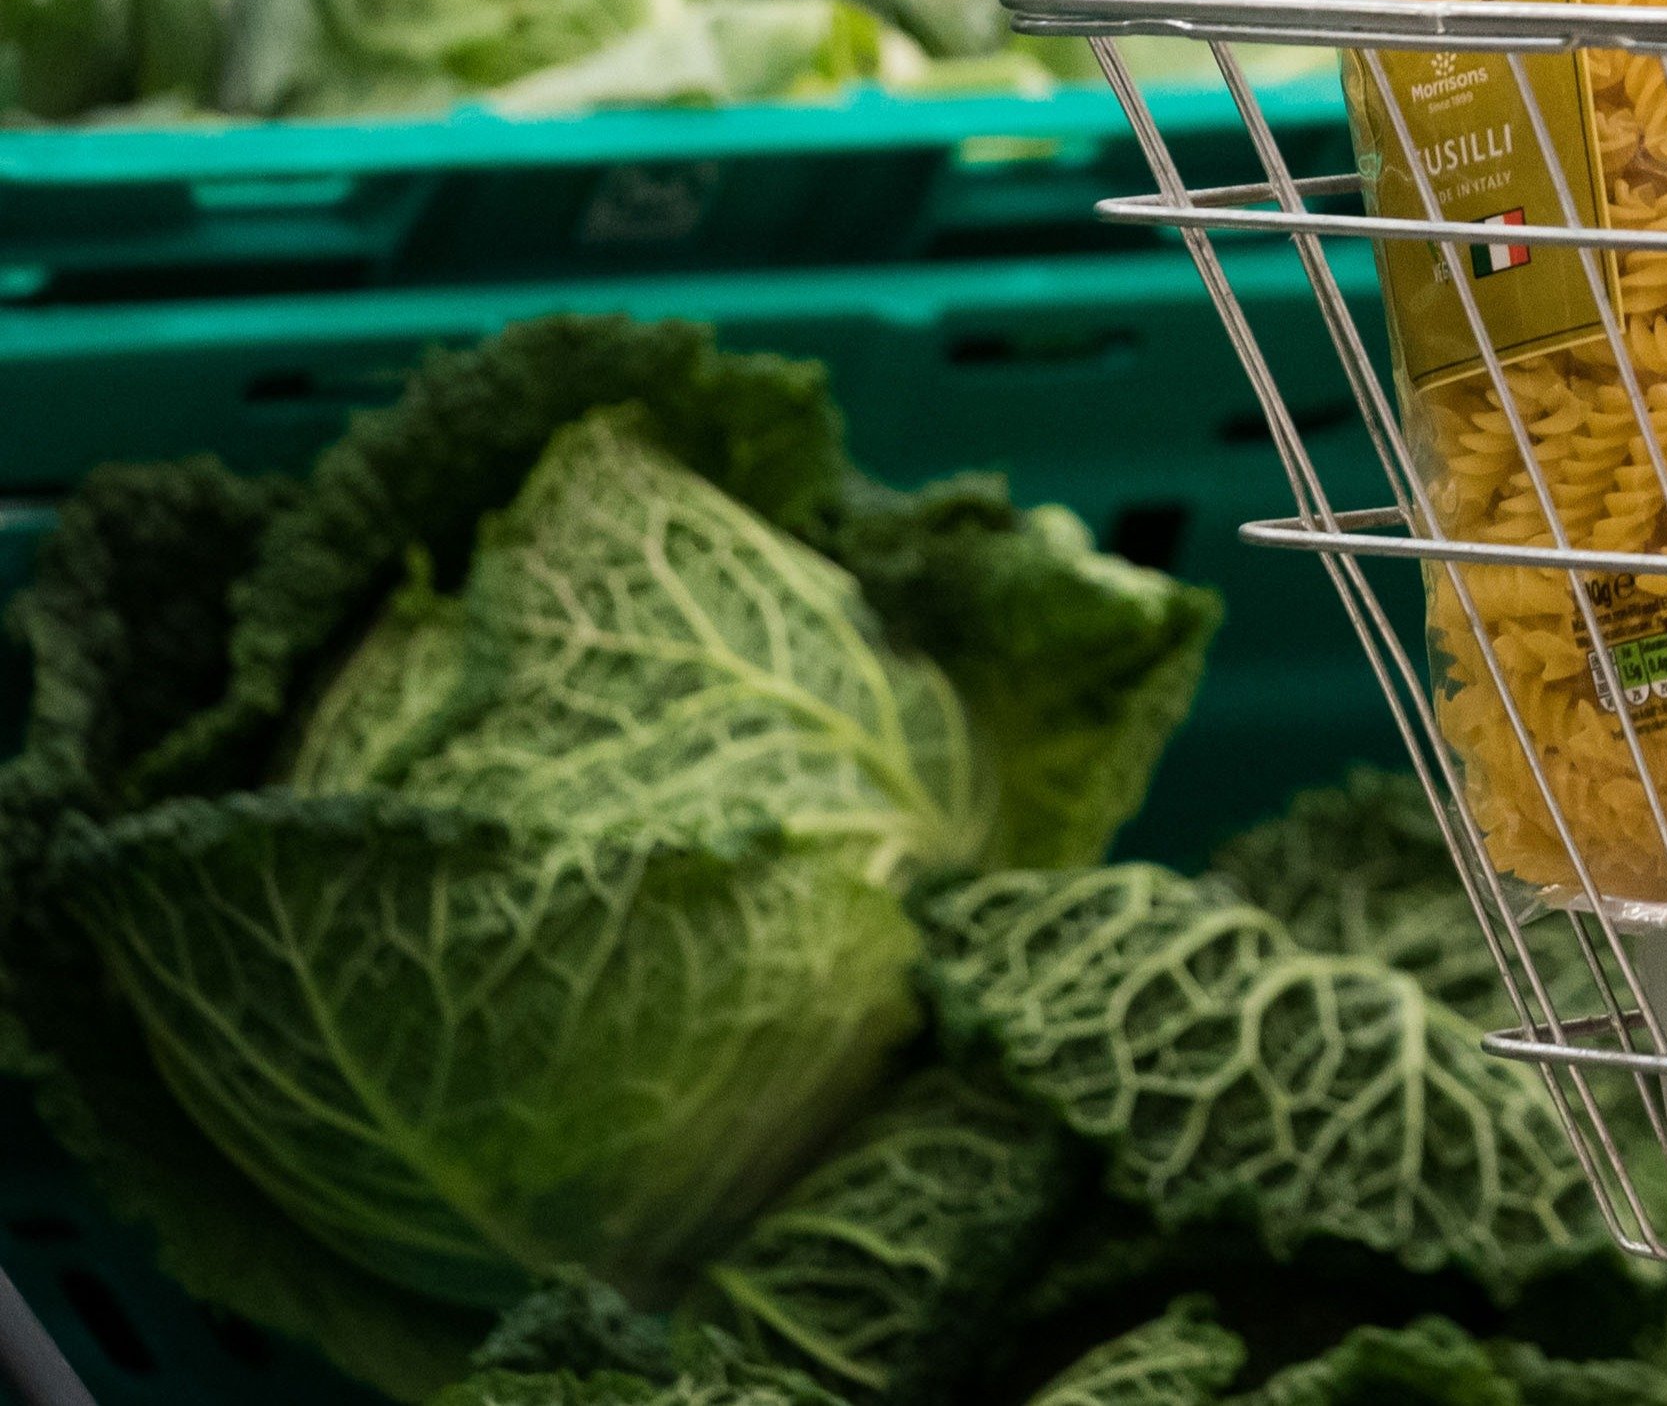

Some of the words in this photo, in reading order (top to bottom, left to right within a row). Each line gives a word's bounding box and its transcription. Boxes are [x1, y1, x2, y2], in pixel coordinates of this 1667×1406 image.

[1411, 66, 1490, 103] Morrisons
[1428, 100, 1449, 114] Since
[1472, 170, 1512, 192] ITALY
